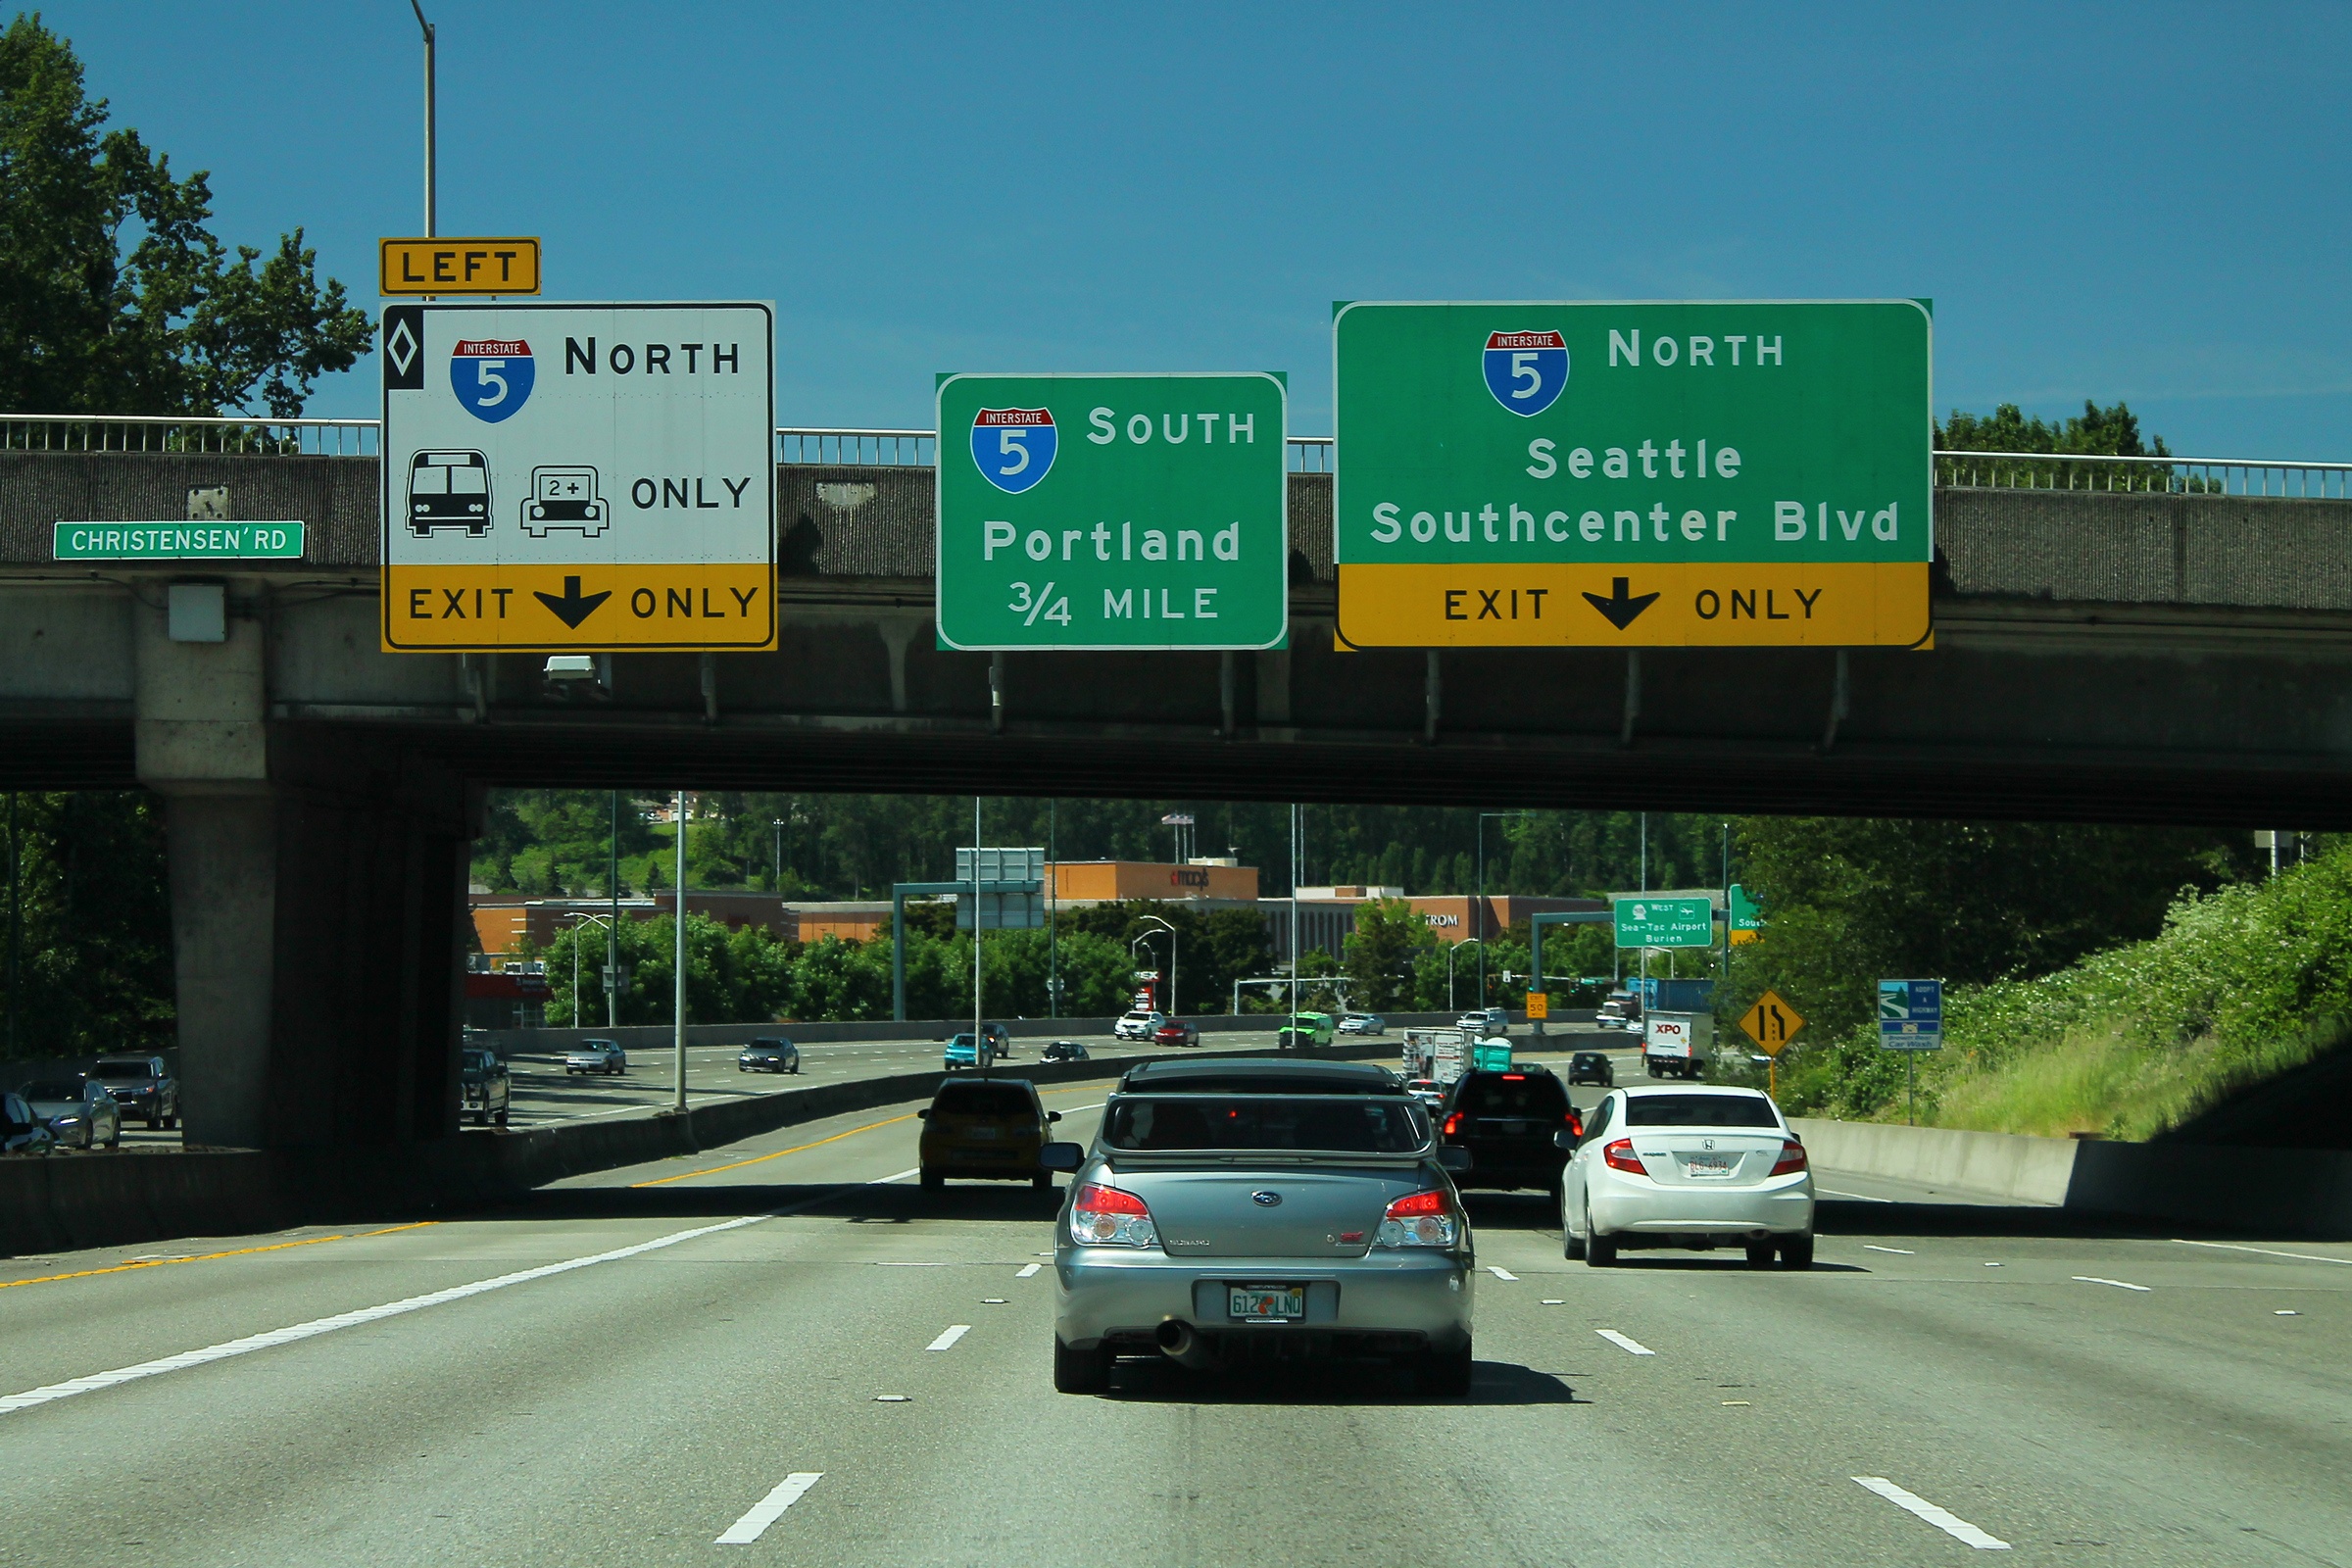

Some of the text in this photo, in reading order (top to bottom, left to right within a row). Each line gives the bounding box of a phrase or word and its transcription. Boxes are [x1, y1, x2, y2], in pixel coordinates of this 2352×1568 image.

[402, 251, 516, 282] LEFT
[464, 343, 521, 356] INTERSTATE
[564, 336, 739, 375] NORTH
[1496, 334, 1554, 347] INTERSTATE
[1607, 328, 1784, 368] NORTH
[477, 360, 509, 407] 5
[1509, 352, 1542, 400] 5
[985, 412, 1043, 424] INTERSTATE
[1086, 406, 1255, 445] SOUTH
[998, 428, 1030, 476] 5
[1525, 437, 1742, 480] Seattle
[630, 477, 752, 510] ONLY
[1370, 500, 1899, 544] Southcenter Blvd
[254, 529, 287, 551] RD
[983, 520, 1240, 562] Portland
[410, 587, 760, 619] EXIT ONLY
[1103, 588, 1219, 619] MILE
[1445, 588, 1823, 621] EXIT ONLY
[1620, 922, 1707, 932] Sea-Tac Airport
[1645, 934, 1683, 943] Burien
[1655, 1024, 1682, 1035] XPO
[1233, 1295, 1258, 1314] 612
